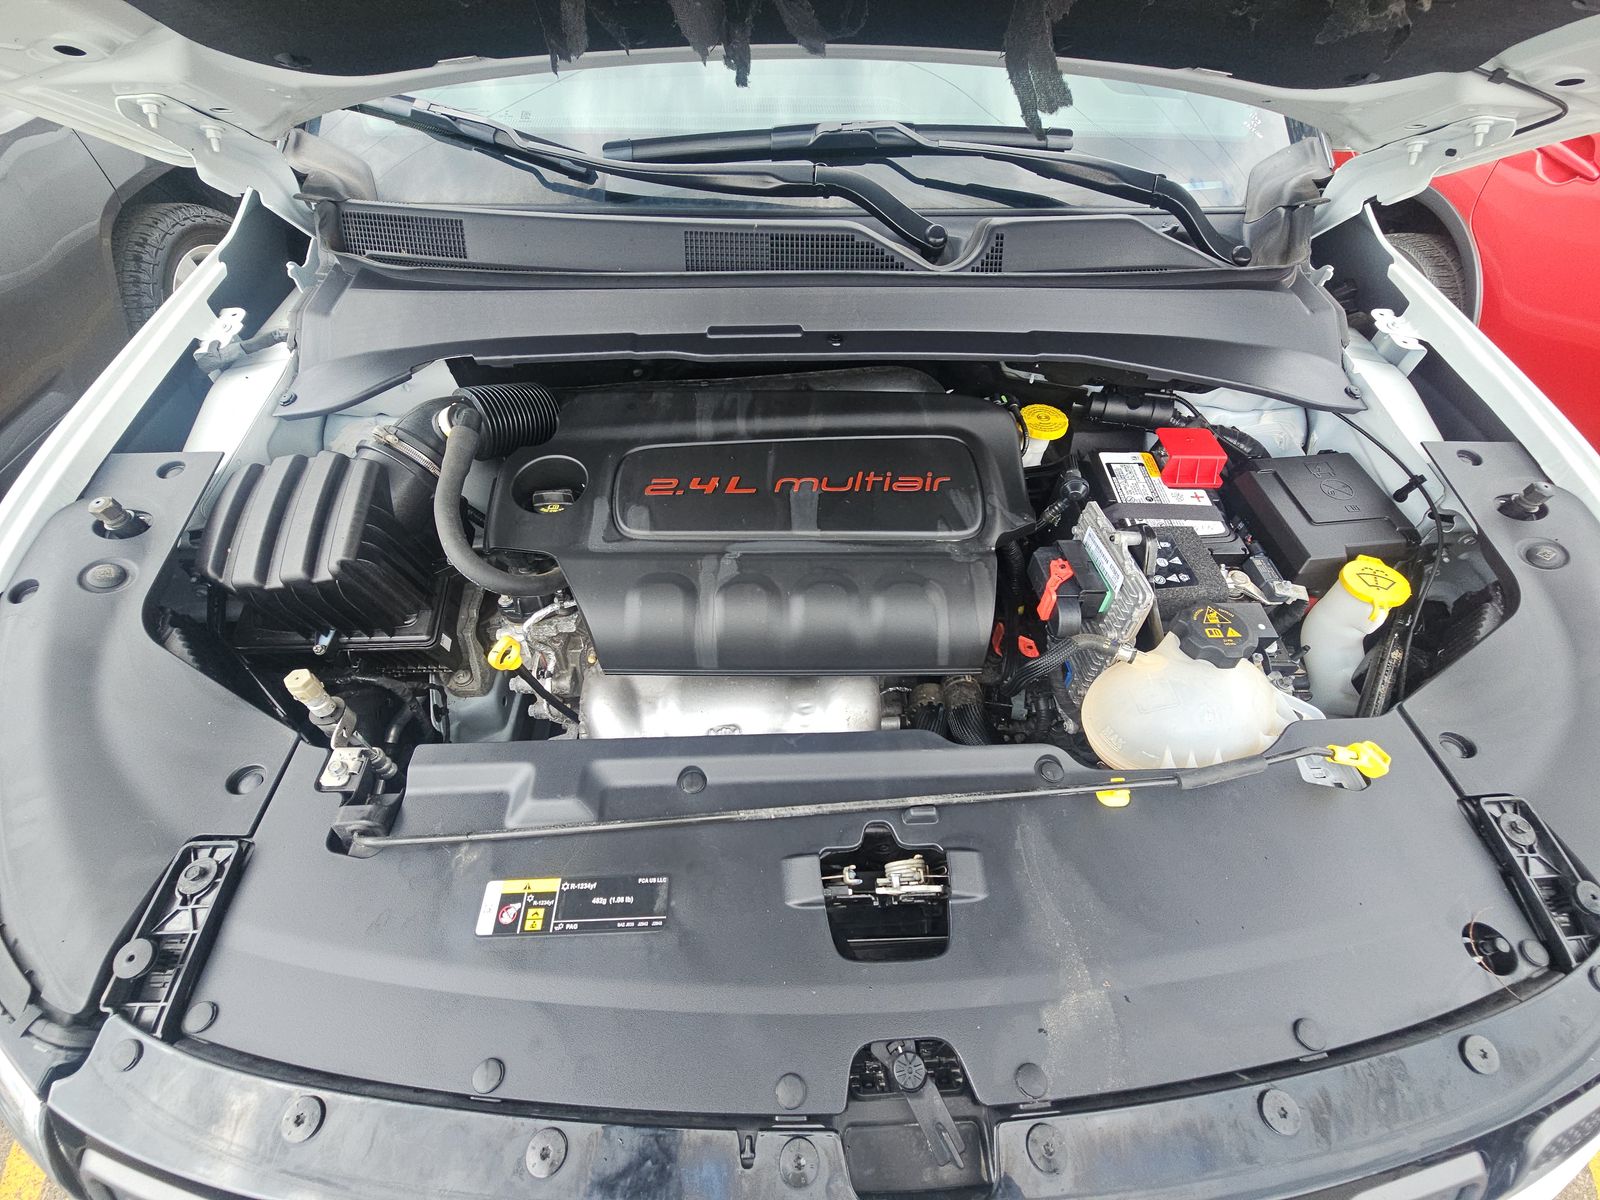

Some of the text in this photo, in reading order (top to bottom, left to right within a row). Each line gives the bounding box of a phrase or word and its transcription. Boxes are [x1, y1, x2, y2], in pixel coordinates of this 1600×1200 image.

[644, 471, 951, 496] 2.4L multiair
[570, 882, 597, 891] R-1234yf
